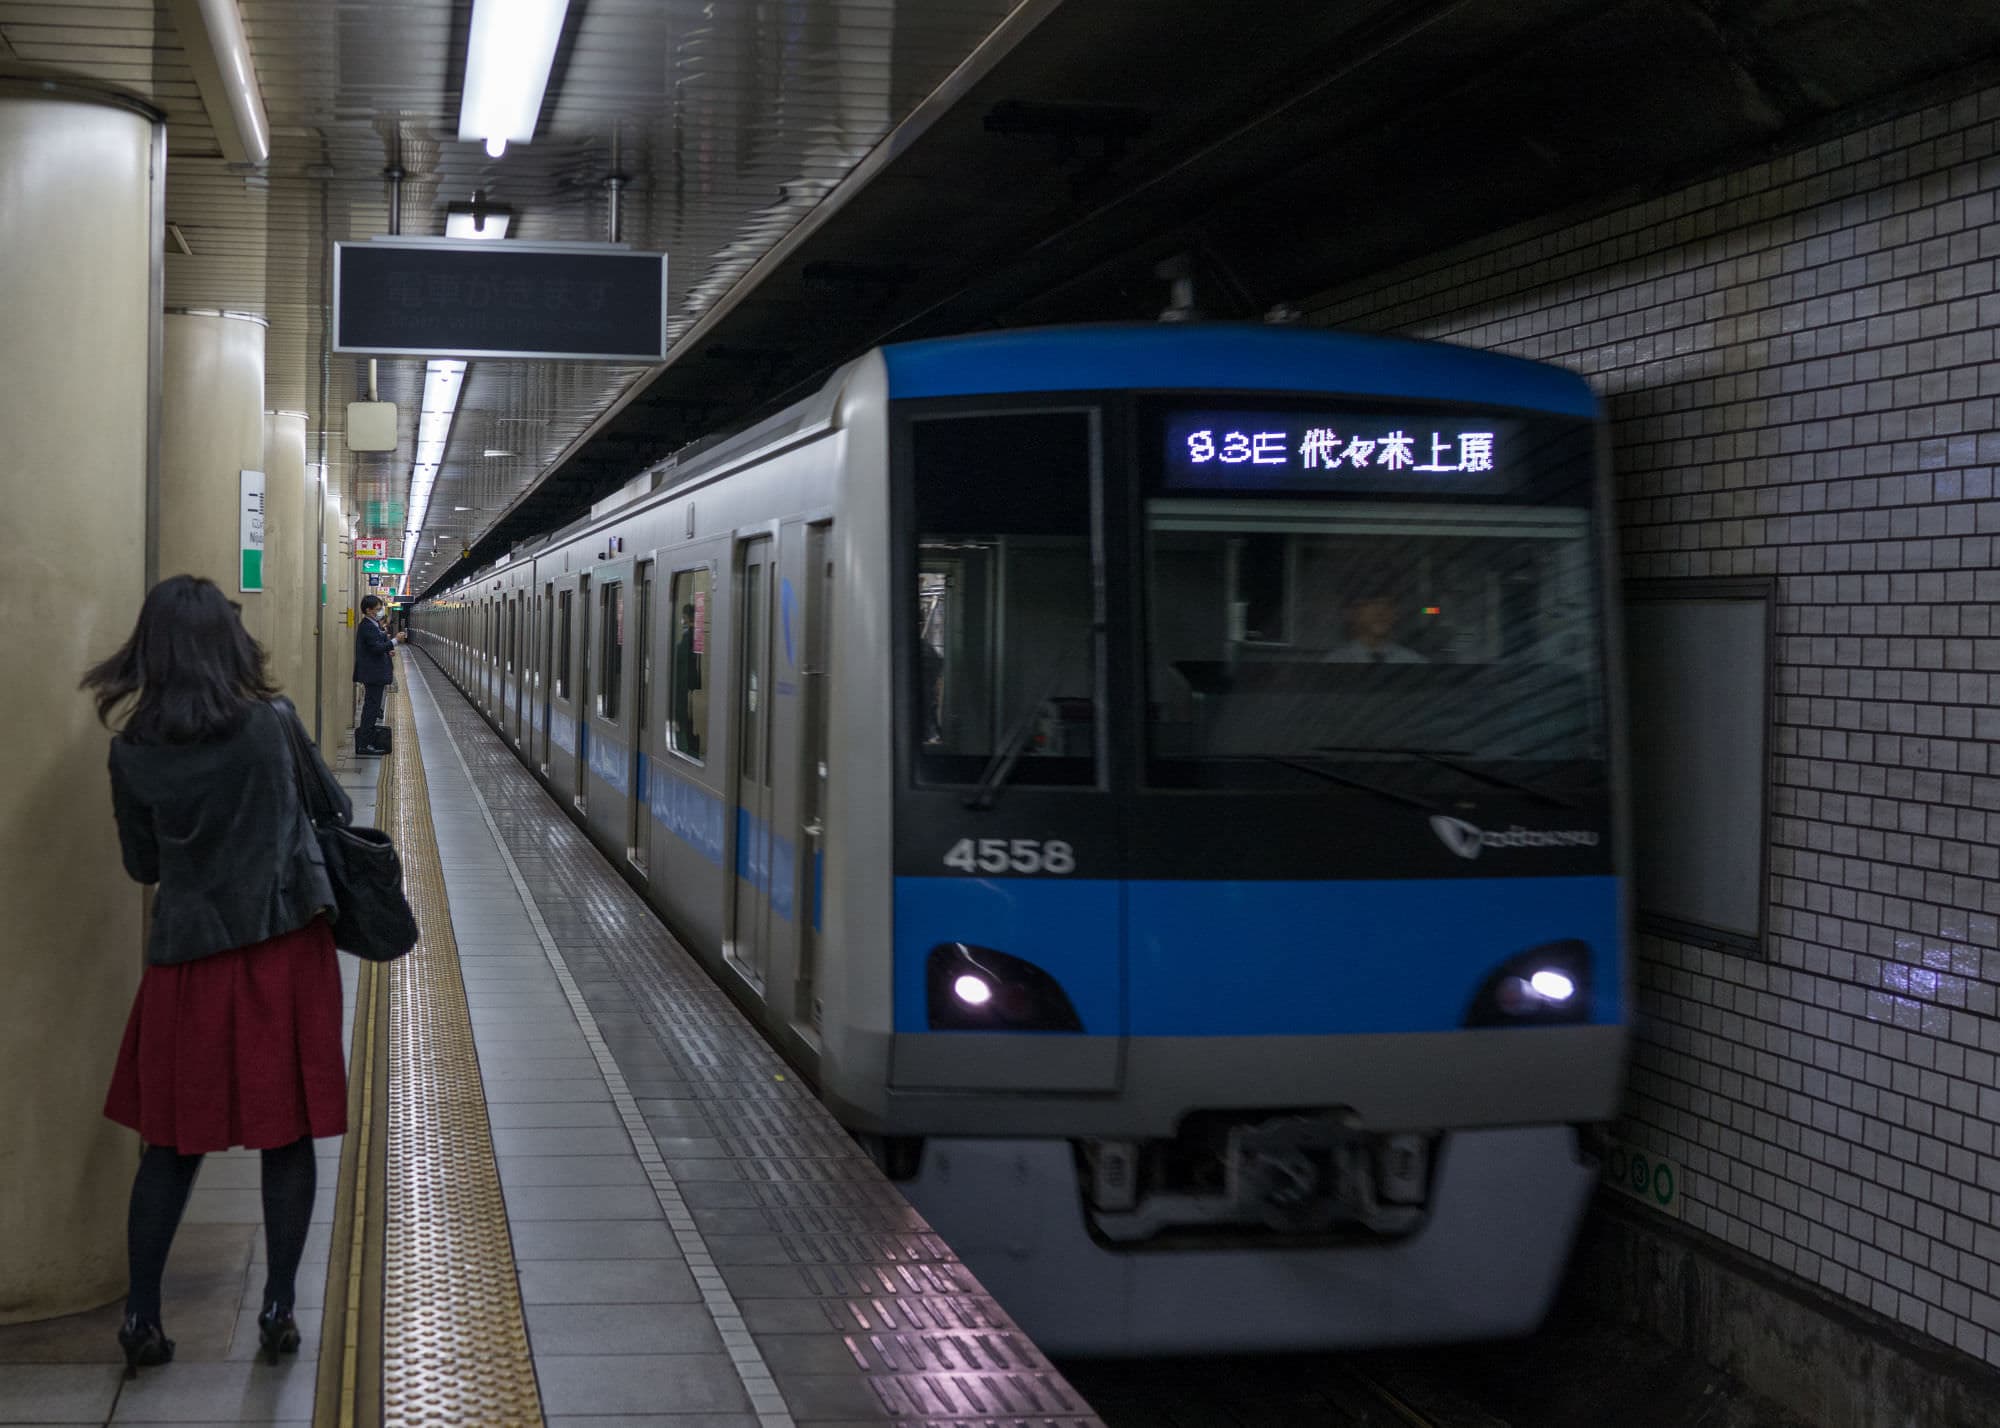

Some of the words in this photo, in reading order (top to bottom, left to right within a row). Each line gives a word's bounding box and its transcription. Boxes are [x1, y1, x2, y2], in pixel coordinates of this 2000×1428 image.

[1298, 427, 1494, 472] 代々木上原
[942, 838, 1076, 874] 4558
